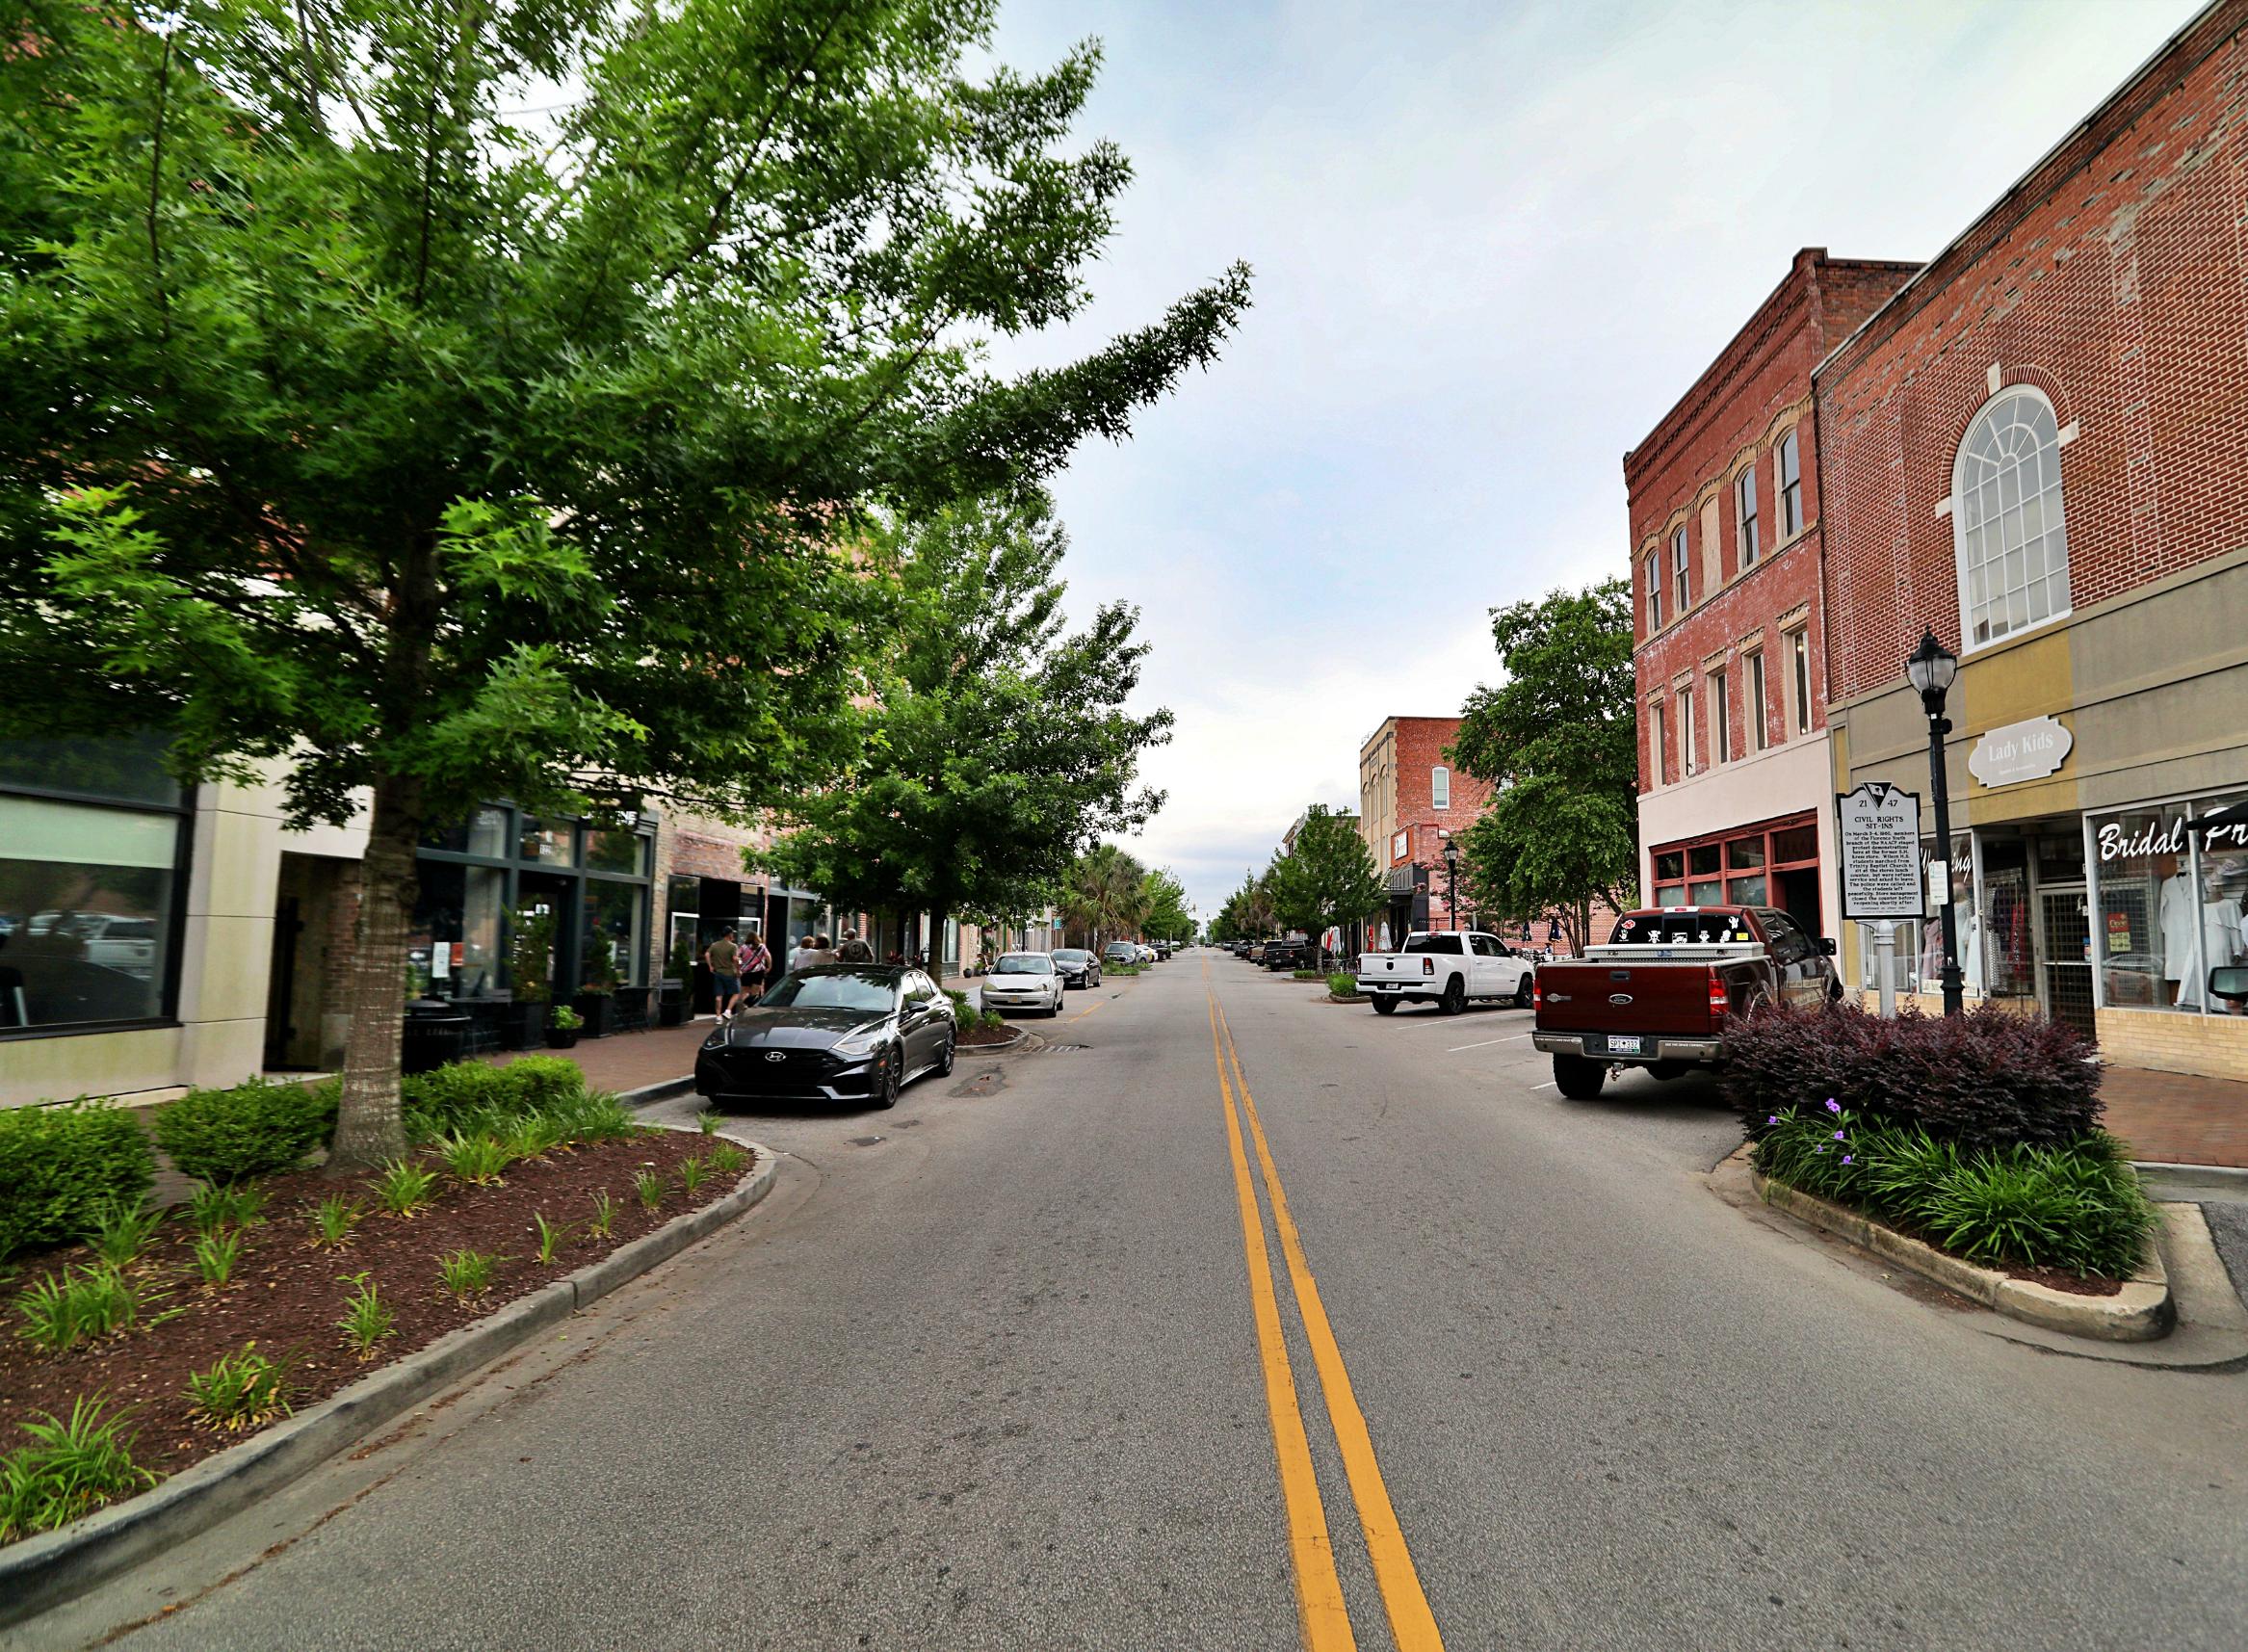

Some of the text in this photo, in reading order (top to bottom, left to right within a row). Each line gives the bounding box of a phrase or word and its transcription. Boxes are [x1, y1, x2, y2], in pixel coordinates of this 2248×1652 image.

[1989, 732, 2054, 762] Lady Kids
[2098, 817, 2183, 861] Bridal
